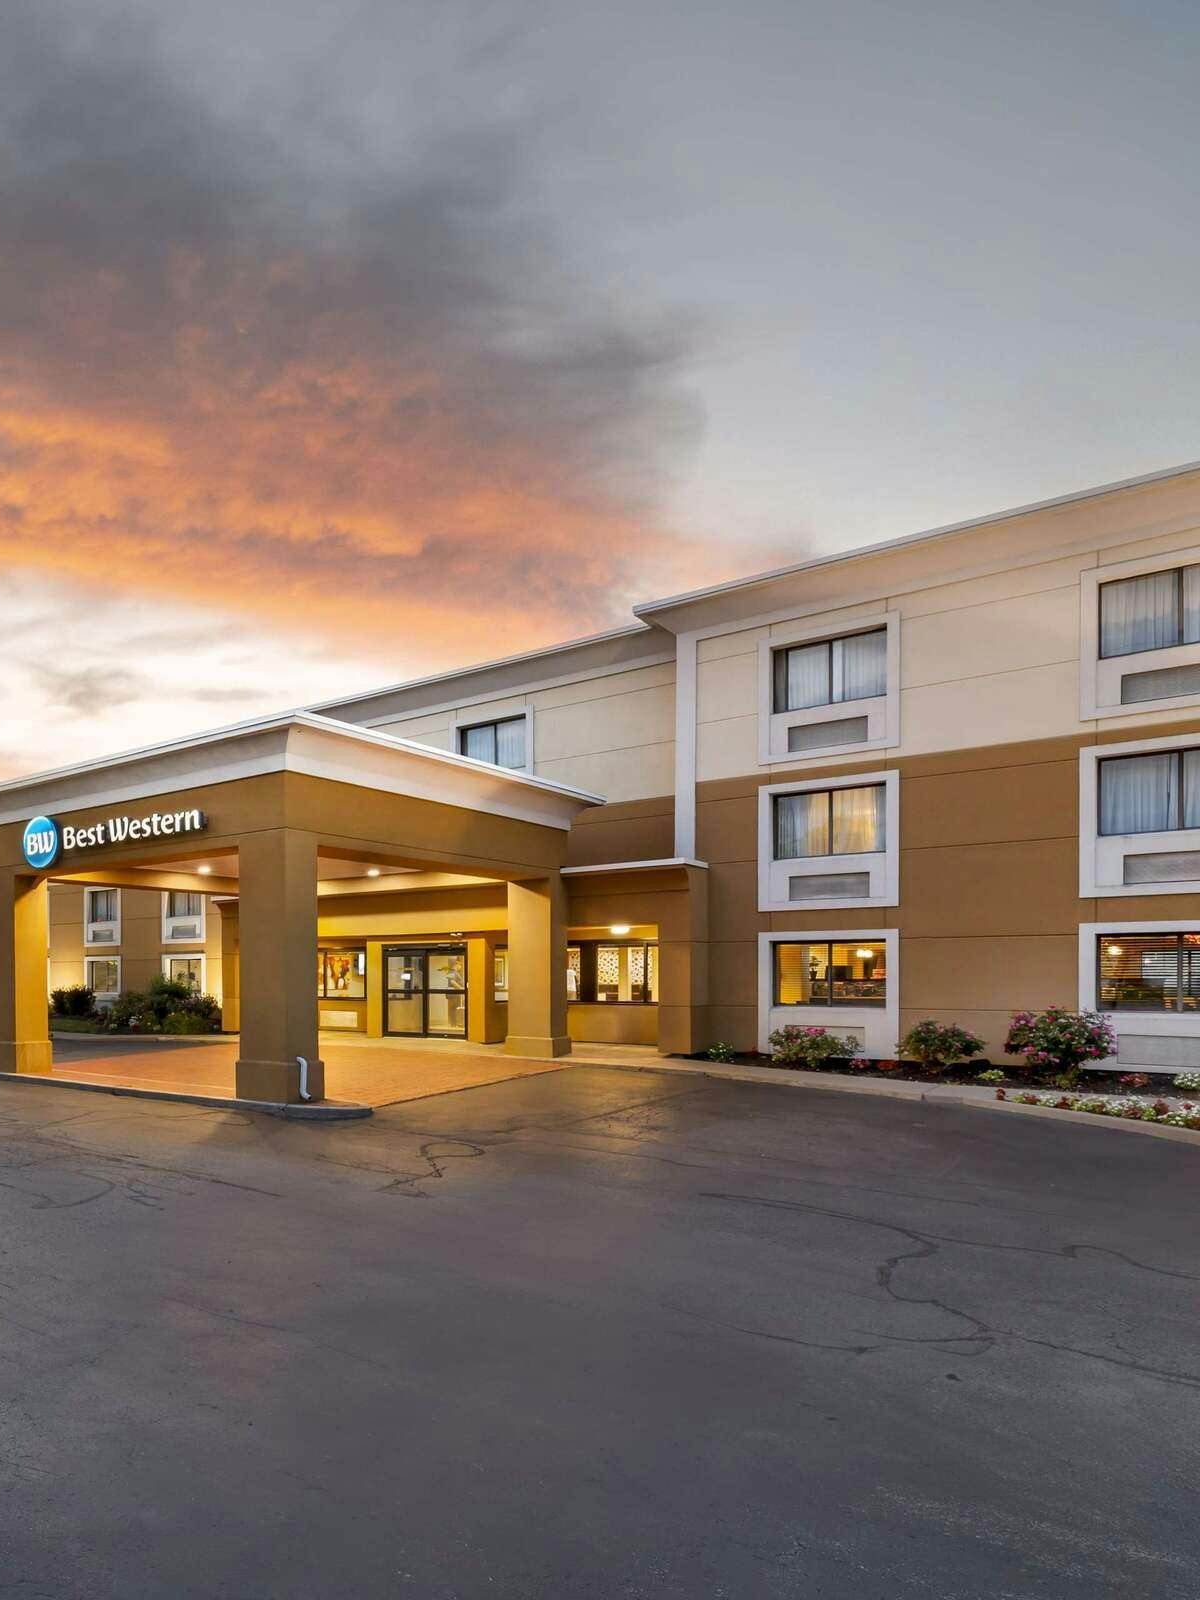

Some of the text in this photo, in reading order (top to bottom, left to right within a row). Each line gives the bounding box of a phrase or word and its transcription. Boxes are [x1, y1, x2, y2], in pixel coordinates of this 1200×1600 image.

[27, 831, 54, 855] BW
[62, 809, 201, 850] Best Western
